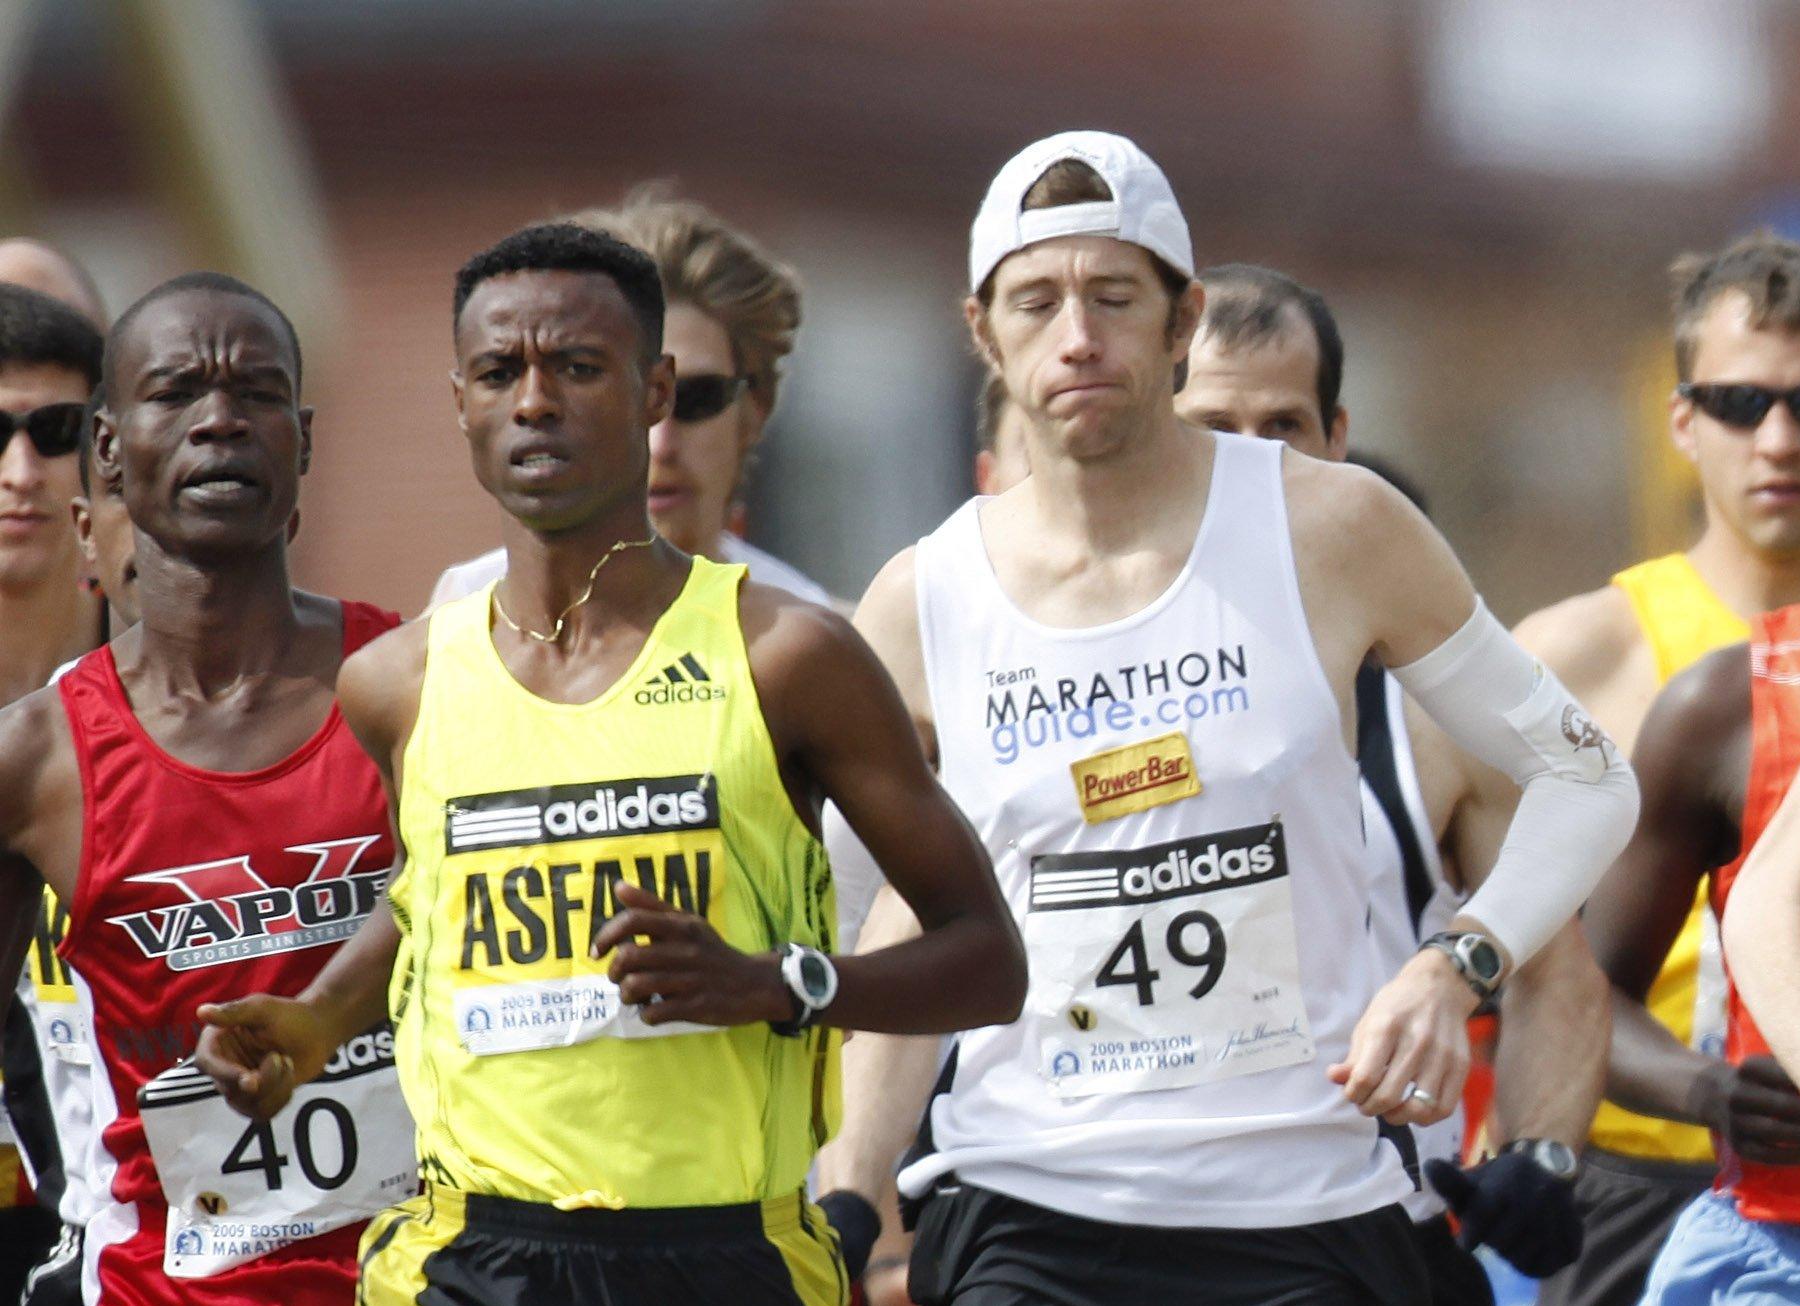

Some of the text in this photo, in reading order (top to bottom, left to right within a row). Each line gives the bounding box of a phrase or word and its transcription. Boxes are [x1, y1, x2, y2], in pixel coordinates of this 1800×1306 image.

[986, 665, 1036, 688] Team
[986, 644, 1247, 728] MARATHON
[634, 683, 726, 706] adidas
[991, 686, 1249, 765] guide.com
[1084, 756, 1185, 800] PowerBar
[544, 785, 708, 837] adidas
[1122, 843, 1275, 897] adidas
[182, 941, 251, 965] SPORTS
[1095, 909, 1227, 1006] 49
[1069, 1010, 1089, 1030] V
[1090, 1035, 1193, 1056] 2009 BOSTON
[1092, 1051, 1195, 1074] MARATHON
[221, 1097, 358, 1191] 40
[199, 1197, 219, 1215] V
[213, 1222, 315, 1239] 2009 BOSTON
